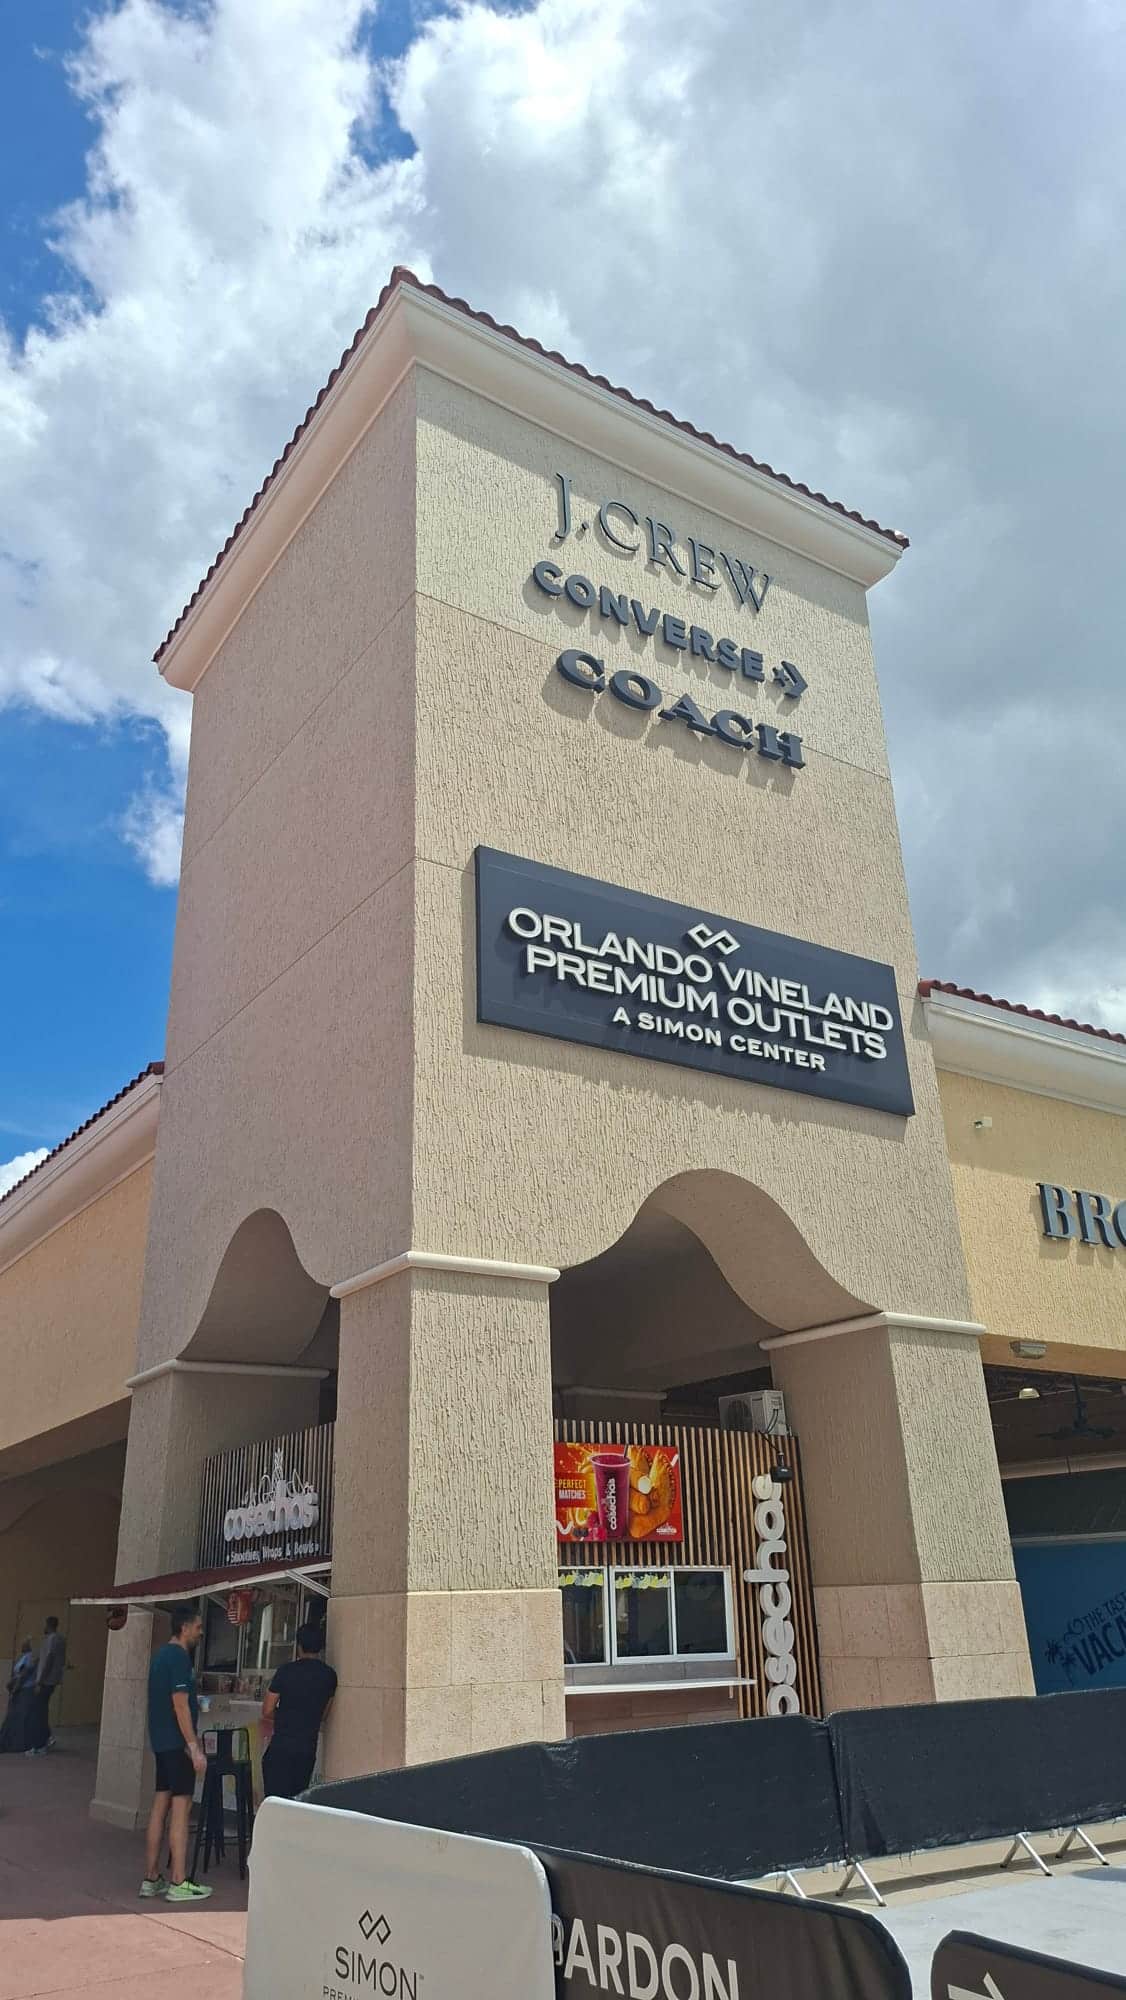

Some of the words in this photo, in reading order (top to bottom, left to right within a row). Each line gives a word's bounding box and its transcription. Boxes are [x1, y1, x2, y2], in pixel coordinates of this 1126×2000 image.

[555, 472, 776, 613] J.CREW
[533, 560, 765, 683] CONVERSE
[556, 648, 806, 770] COACH
[508, 907, 713, 984] ORLANDO
[718, 961, 893, 1032] VINELAND
[526, 944, 719, 1019] PREMIUM
[727, 997, 888, 1060] OUTLETS
[613, 1007, 630, 1024] A
[638, 1011, 722, 1048] SIMON
[730, 1035, 826, 1072] CENTER
[224, 1480, 319, 1542] cosechas
[559, 1479, 586, 1489] PERFECT
[559, 1490, 586, 1499] MATCHES
[1081, 1607, 1103, 1632] THE
[335, 1946, 417, 2000] SIMON
